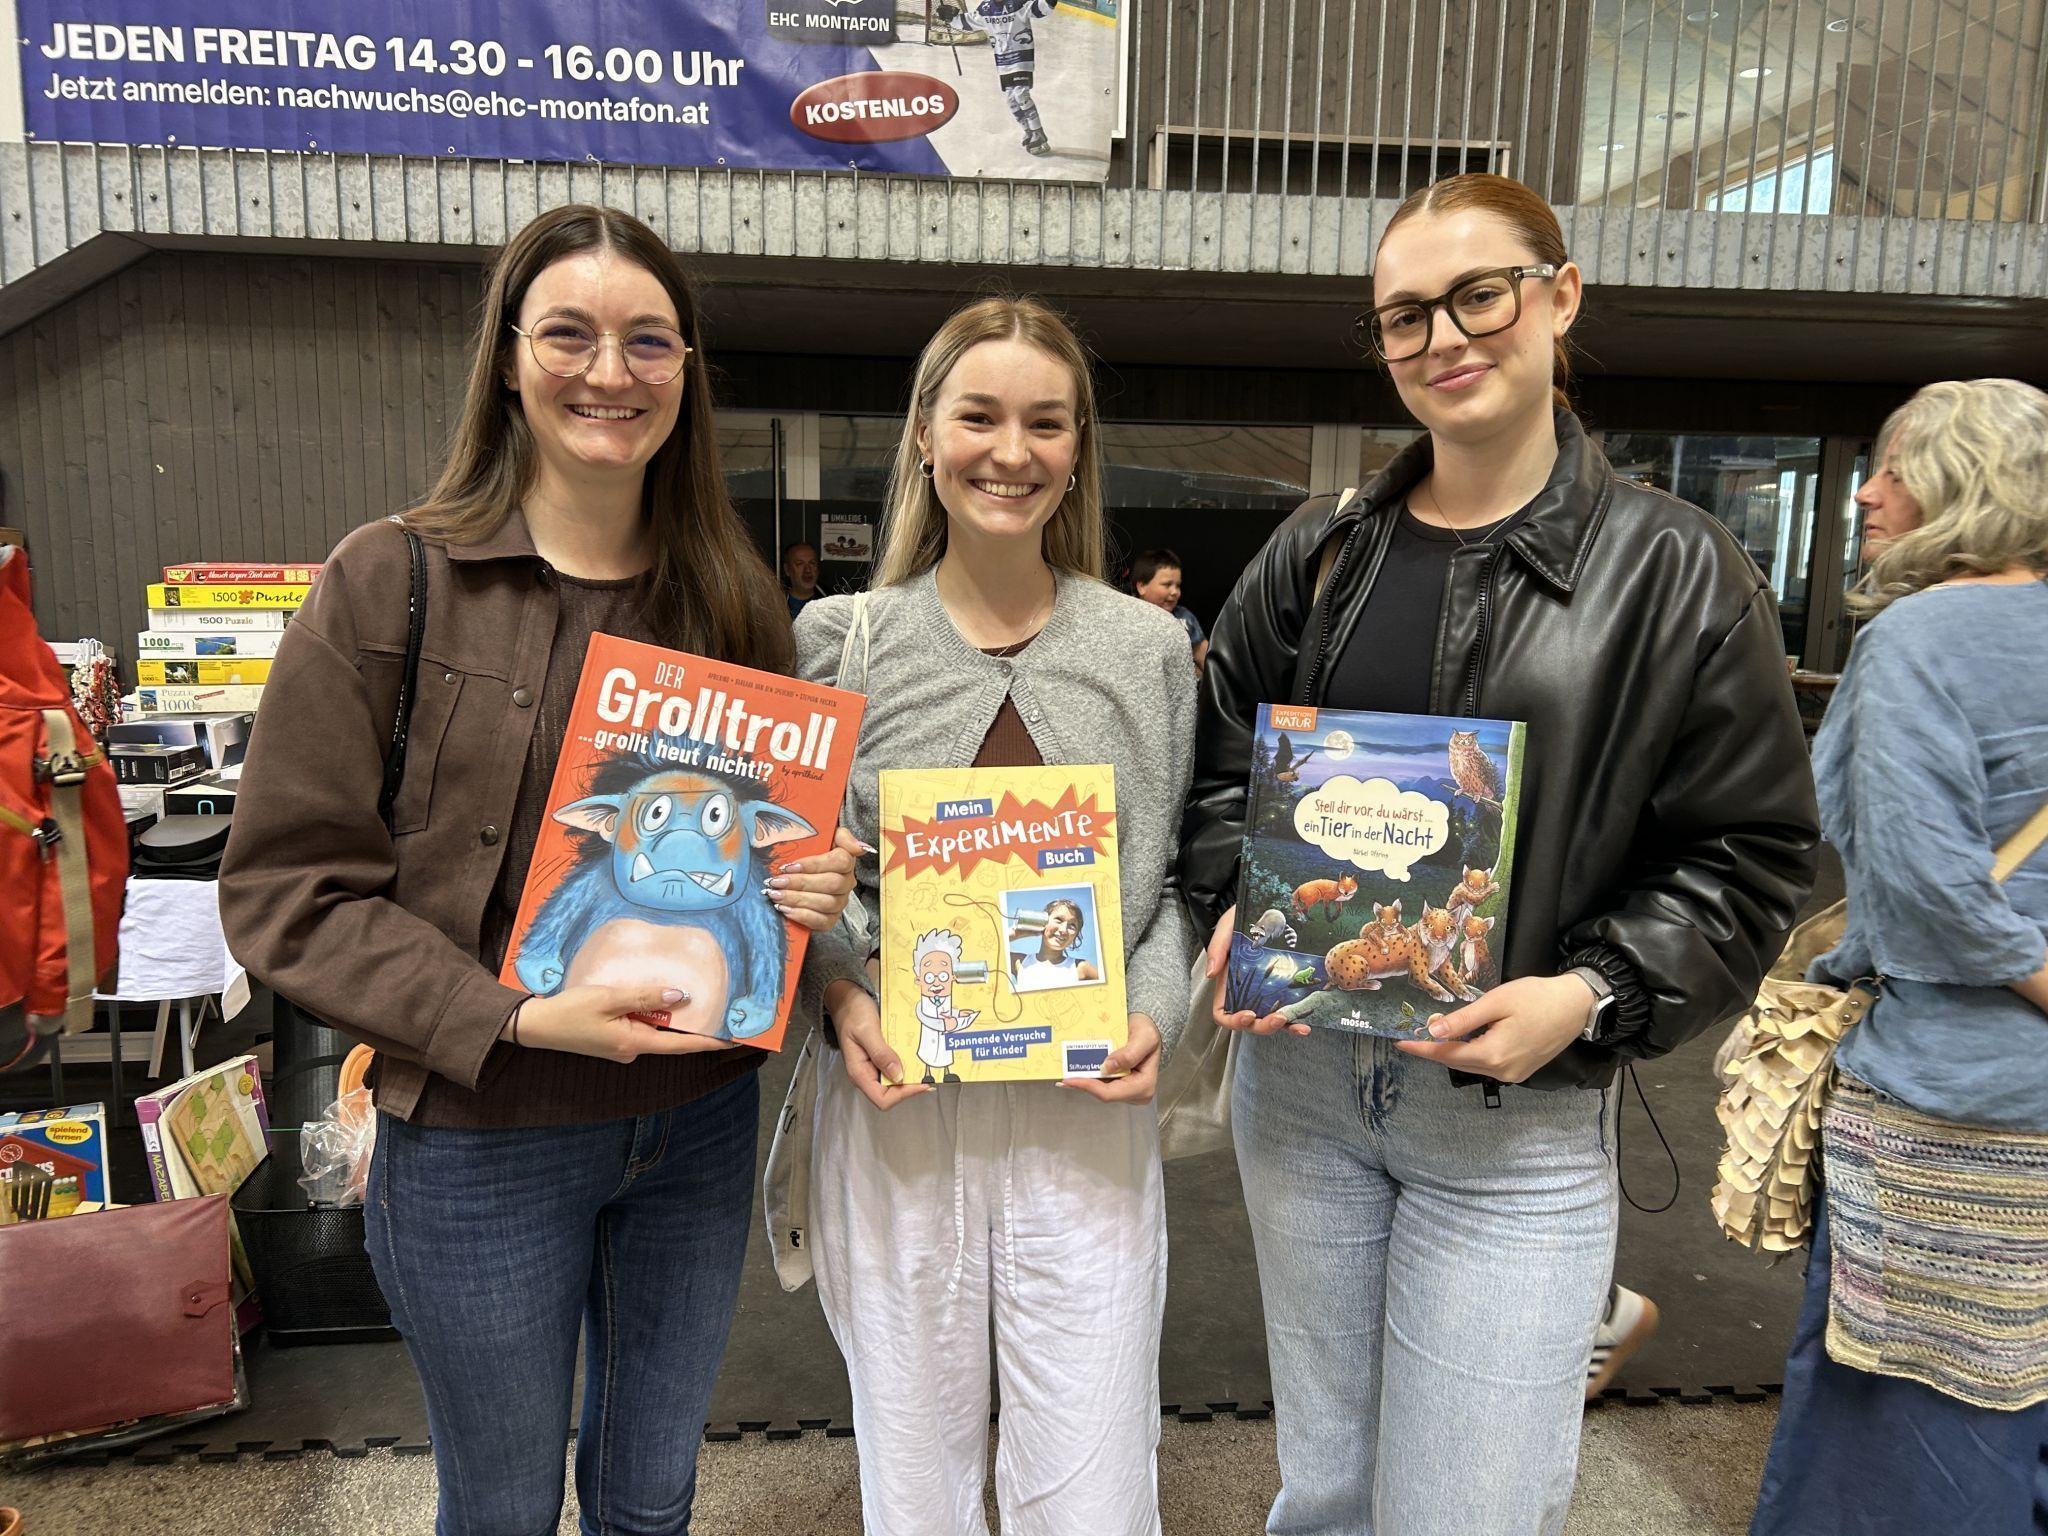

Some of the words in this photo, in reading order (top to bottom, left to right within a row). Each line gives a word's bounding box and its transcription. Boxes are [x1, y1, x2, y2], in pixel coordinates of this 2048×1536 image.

[769, 12, 799, 28] EHC
[805, 14, 890, 32] MONTAFON
[40, 23, 186, 63] JEDEN
[193, 27, 377, 71] FREITAG
[385, 37, 506, 76] 14.30
[517, 58, 534, 68] -
[544, 44, 663, 83] 16.00
[673, 51, 745, 86] Uhr
[44, 73, 116, 101] Jetzt
[122, 78, 271, 106] anmelden:
[277, 83, 710, 125] nachwuchs@ehc-montafon.at
[805, 94, 945, 125] KOSTENLOS
[213, 592, 238, 602] 1500
[256, 592, 303, 602] Puzzle
[198, 617, 223, 625] 1500
[225, 617, 253, 625] Puzzle
[143, 638, 171, 647] 1000
[654, 661, 685, 690] DER
[162, 699, 195, 712] 1000
[596, 667, 838, 770] Grolltroll
[1275, 716, 1312, 728] NATUR
[655, 738, 701, 767] heut
[706, 753, 774, 782] nicht!?
[943, 802, 984, 818] Mein
[1315, 799, 1335, 814] Stell
[1337, 800, 1352, 815] dir
[1354, 804, 1374, 818] vor,
[1376, 804, 1390, 818] du
[1304, 820, 1319, 833] ein
[1320, 816, 1352, 838] Tier
[1352, 828, 1362, 838] in
[1364, 826, 1382, 840] der
[1383, 822, 1433, 849] Nacht
[1045, 849, 1085, 866] Buch
[948, 1033, 1000, 1048] Spannende
[1002, 1029, 1047, 1042] Versuche
[975, 1047, 990, 1057] für
[992, 1044, 1024, 1056] Kinder
[1069, 1063, 1091, 1071] Stiftung
[49, 1125, 88, 1136] spielend
[53, 1133, 82, 1142] lernen
